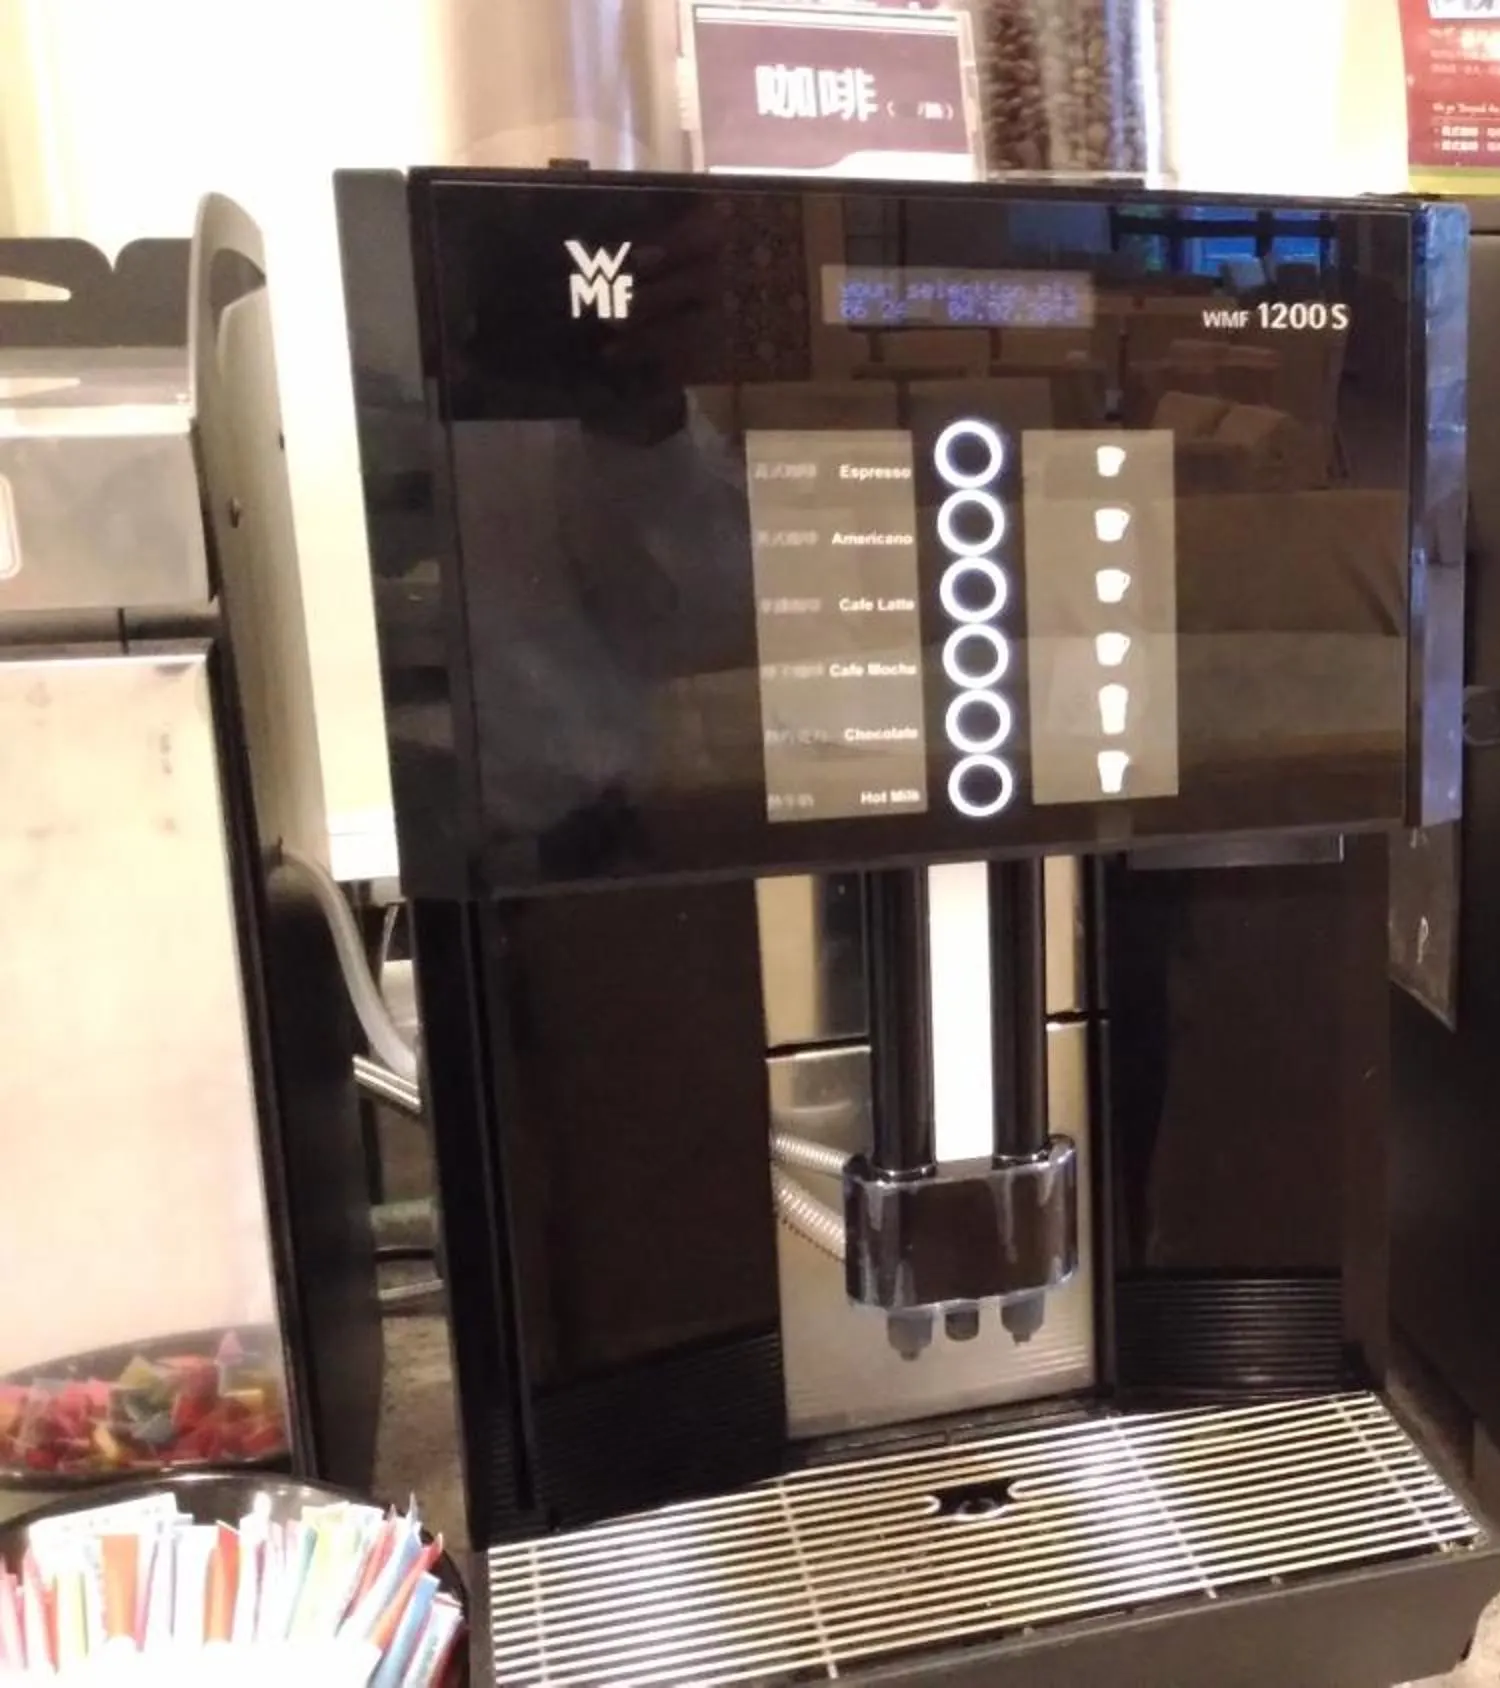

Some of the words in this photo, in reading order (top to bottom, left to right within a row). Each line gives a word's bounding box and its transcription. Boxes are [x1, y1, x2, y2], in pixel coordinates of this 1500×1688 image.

[755, 63, 878, 121] 咖啡
[563, 239, 633, 319] WMF
[1202, 309, 1249, 329] WMF
[839, 463, 912, 481] Espresso
[831, 530, 914, 545] Americano
[877, 598, 915, 612] Latte
[867, 662, 917, 677] Mocha
[844, 727, 919, 742] Chocolate
[860, 790, 887, 805] Hot
[890, 789, 921, 803] Milk
